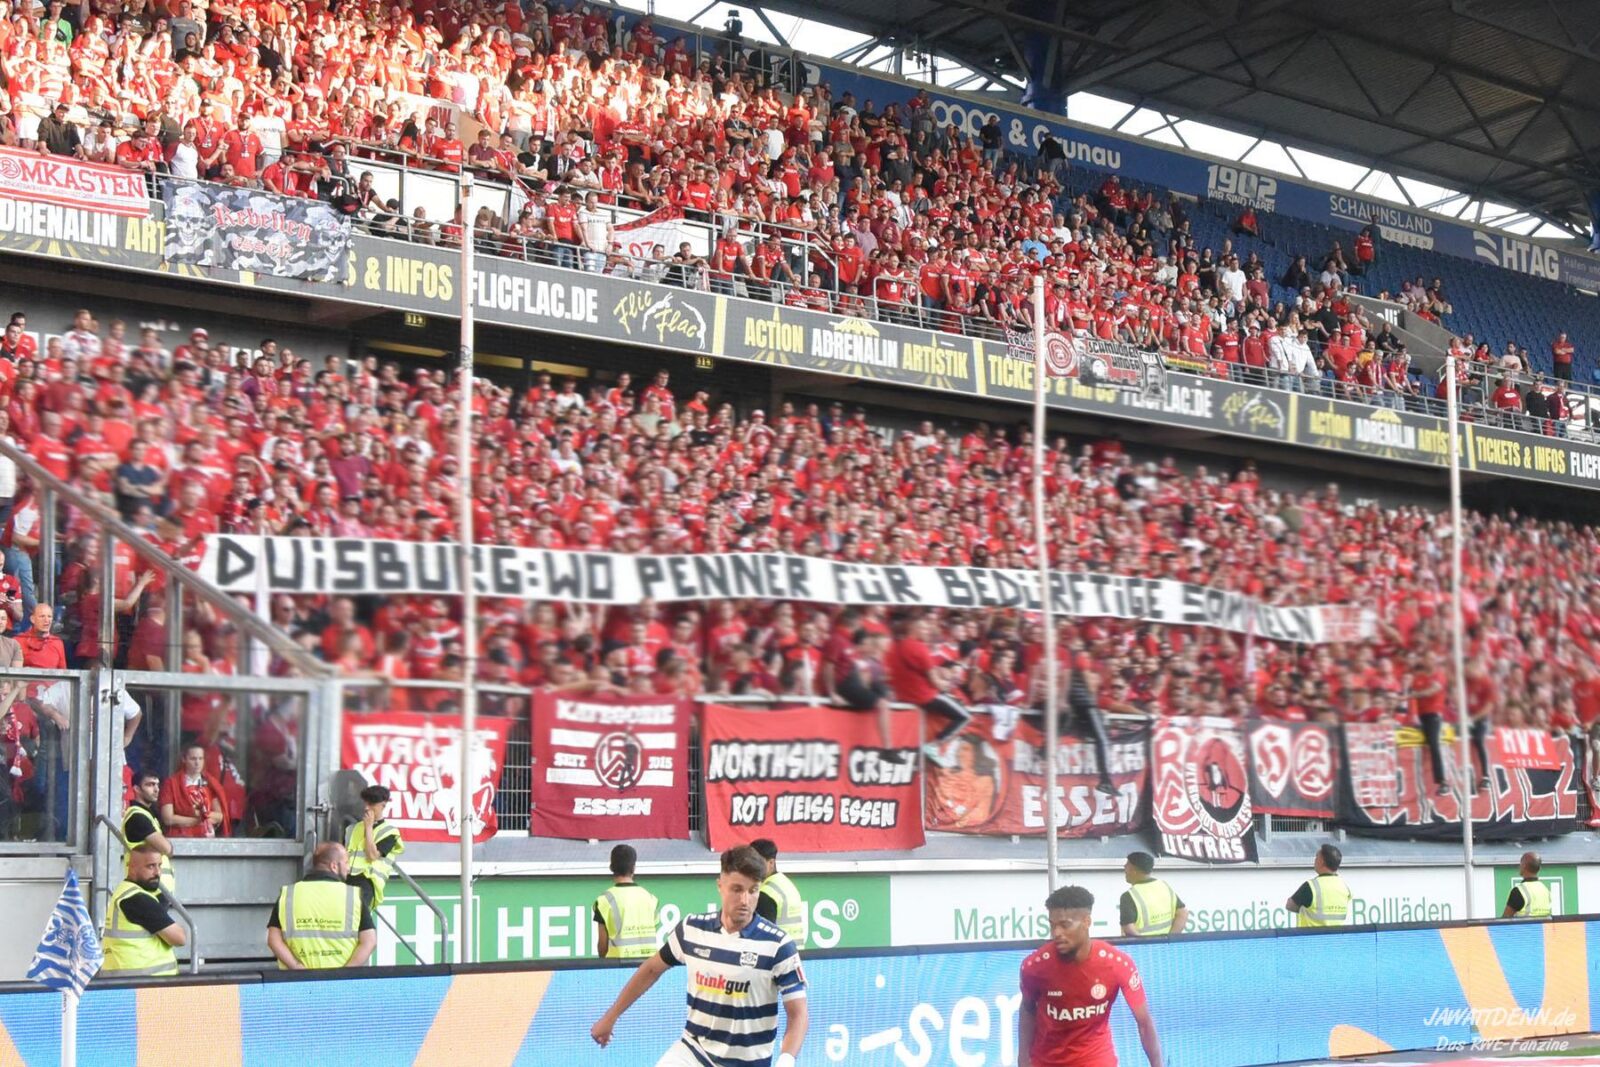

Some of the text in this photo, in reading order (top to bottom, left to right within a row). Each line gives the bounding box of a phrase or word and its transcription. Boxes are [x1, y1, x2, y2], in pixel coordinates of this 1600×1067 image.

[1008, 118, 1028, 148] &
[1207, 164, 1277, 204] 1902
[364, 262, 381, 291] &
[386, 256, 453, 301] INFOS
[1502, 236, 1560, 281] HTAG
[613, 290, 699, 343] Flic Flac
[744, 315, 968, 379] ACTION ADRENALIN ARTISTIK
[1475, 435, 1521, 468] TICKETS
[1523, 446, 1532, 470] &
[1534, 445, 1566, 475] INFOS
[635, 556, 811, 597] PENNER
[831, 563, 922, 602] FÜR
[708, 740, 840, 781] NORTHSIDE
[572, 797, 652, 816] ESSEN
[731, 795, 897, 828] ROT WEISS ESSEN
[1162, 832, 1246, 860] ULTRAS
[497, 904, 598, 959] HEI
[953, 907, 1050, 941] Markis
[1352, 897, 1452, 925] Rollläden
[695, 971, 751, 995] trinkgut
